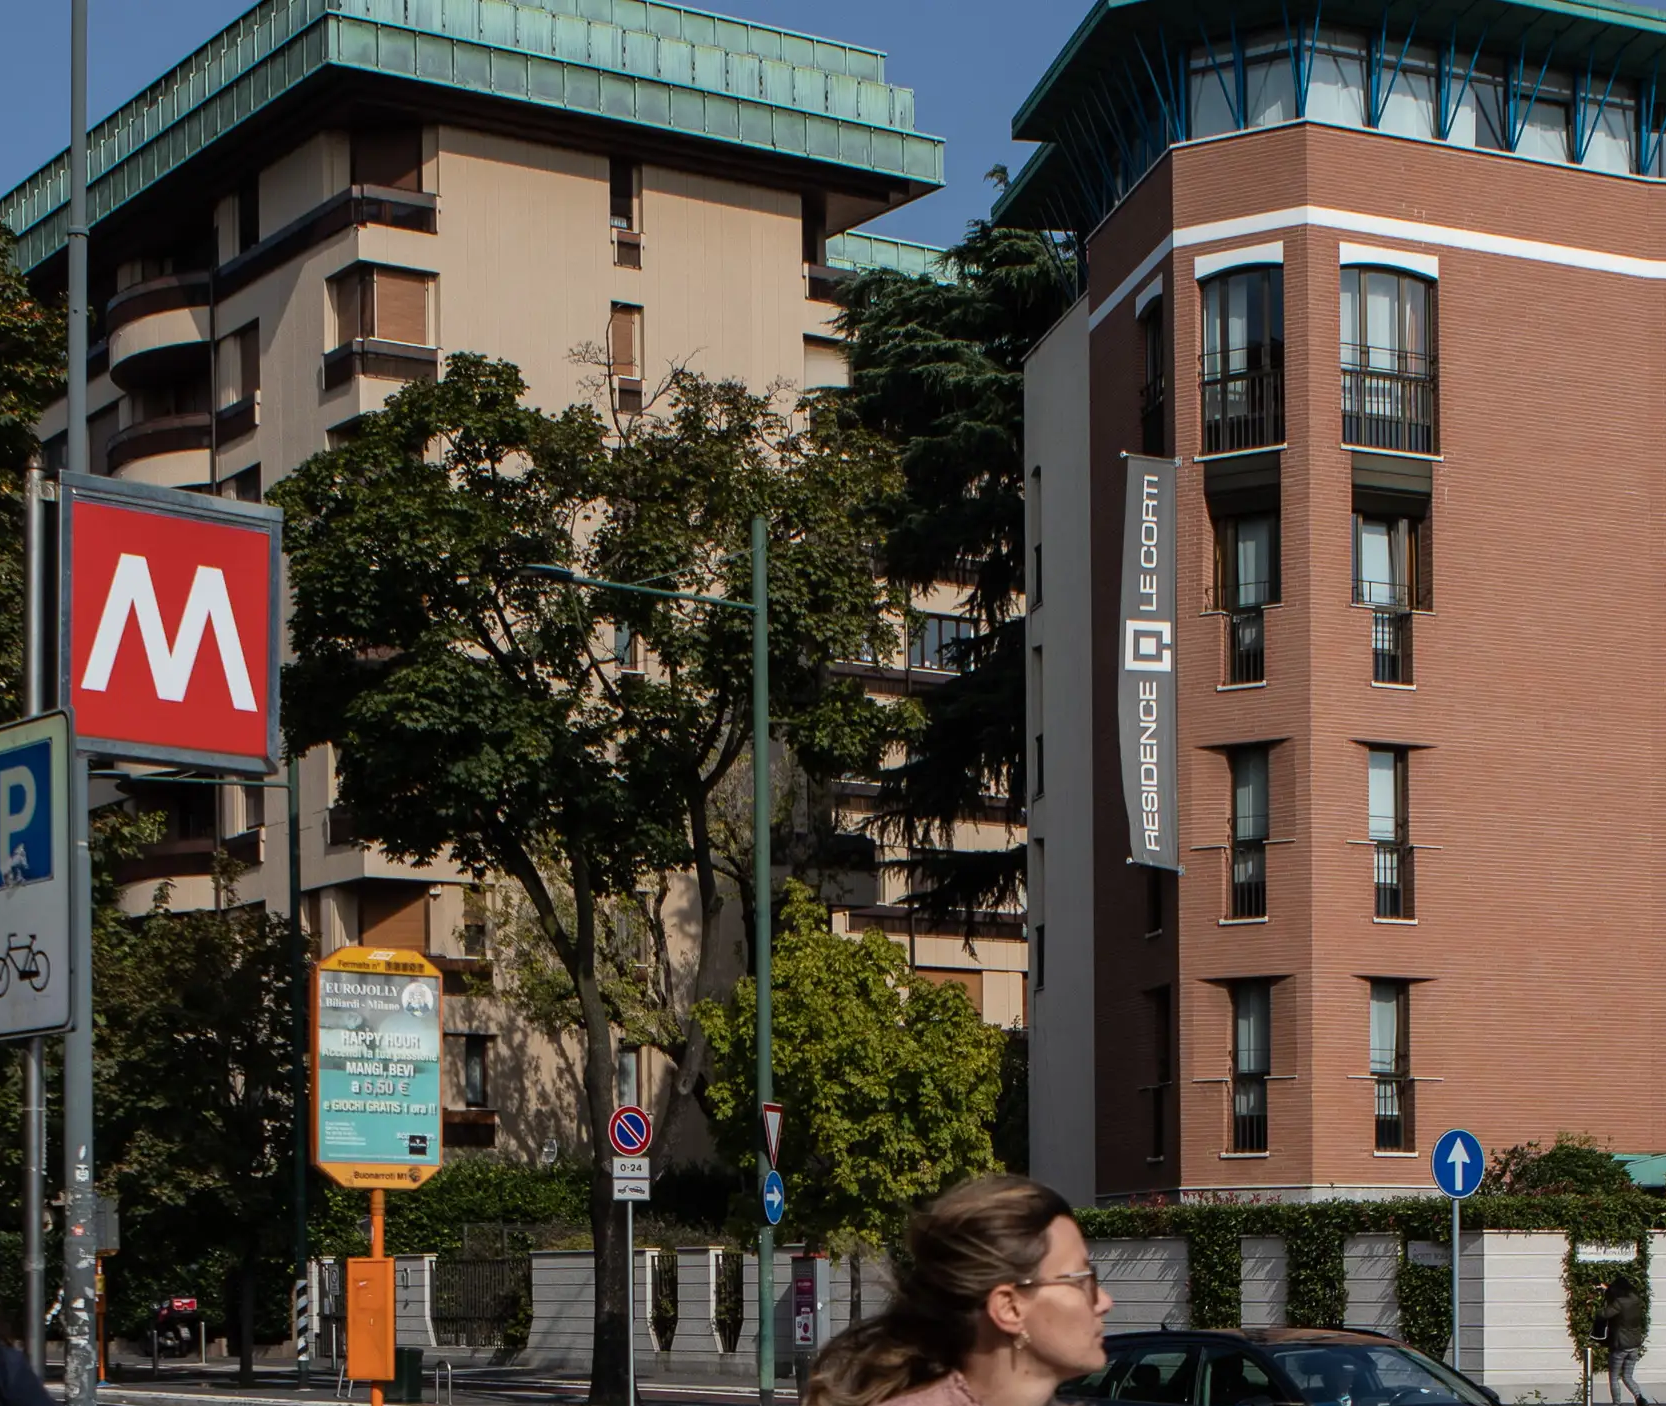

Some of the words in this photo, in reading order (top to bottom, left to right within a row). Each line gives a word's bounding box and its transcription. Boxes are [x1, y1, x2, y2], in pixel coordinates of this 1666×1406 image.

[1140, 474, 1159, 569] CORTI
[1139, 575, 1158, 612] LE
[81, 552, 258, 712] M
[1139, 681, 1161, 852] RESIDENCE
[325, 982, 400, 997] EUROJOLLY
[326, 997, 360, 1008] Biliardi
[368, 999, 400, 1011] Milano
[341, 1030, 382, 1047] HAPPY
[384, 1033, 421, 1049] HOUR
[393, 1050, 439, 1062] passione
[346, 1062, 388, 1079] MANGI,
[389, 1063, 415, 1077] BEVI
[351, 1081, 361, 1094] a
[364, 1080, 395, 1096] 6,50
[398, 1080, 411, 1096] €
[323, 1101, 331, 1111] e
[332, 1100, 366, 1113] GIOCHI
[366, 1101, 402, 1114] GRATIS
[353, 1170, 396, 1180] Buonarroti
[397, 1172, 408, 1180] M1
